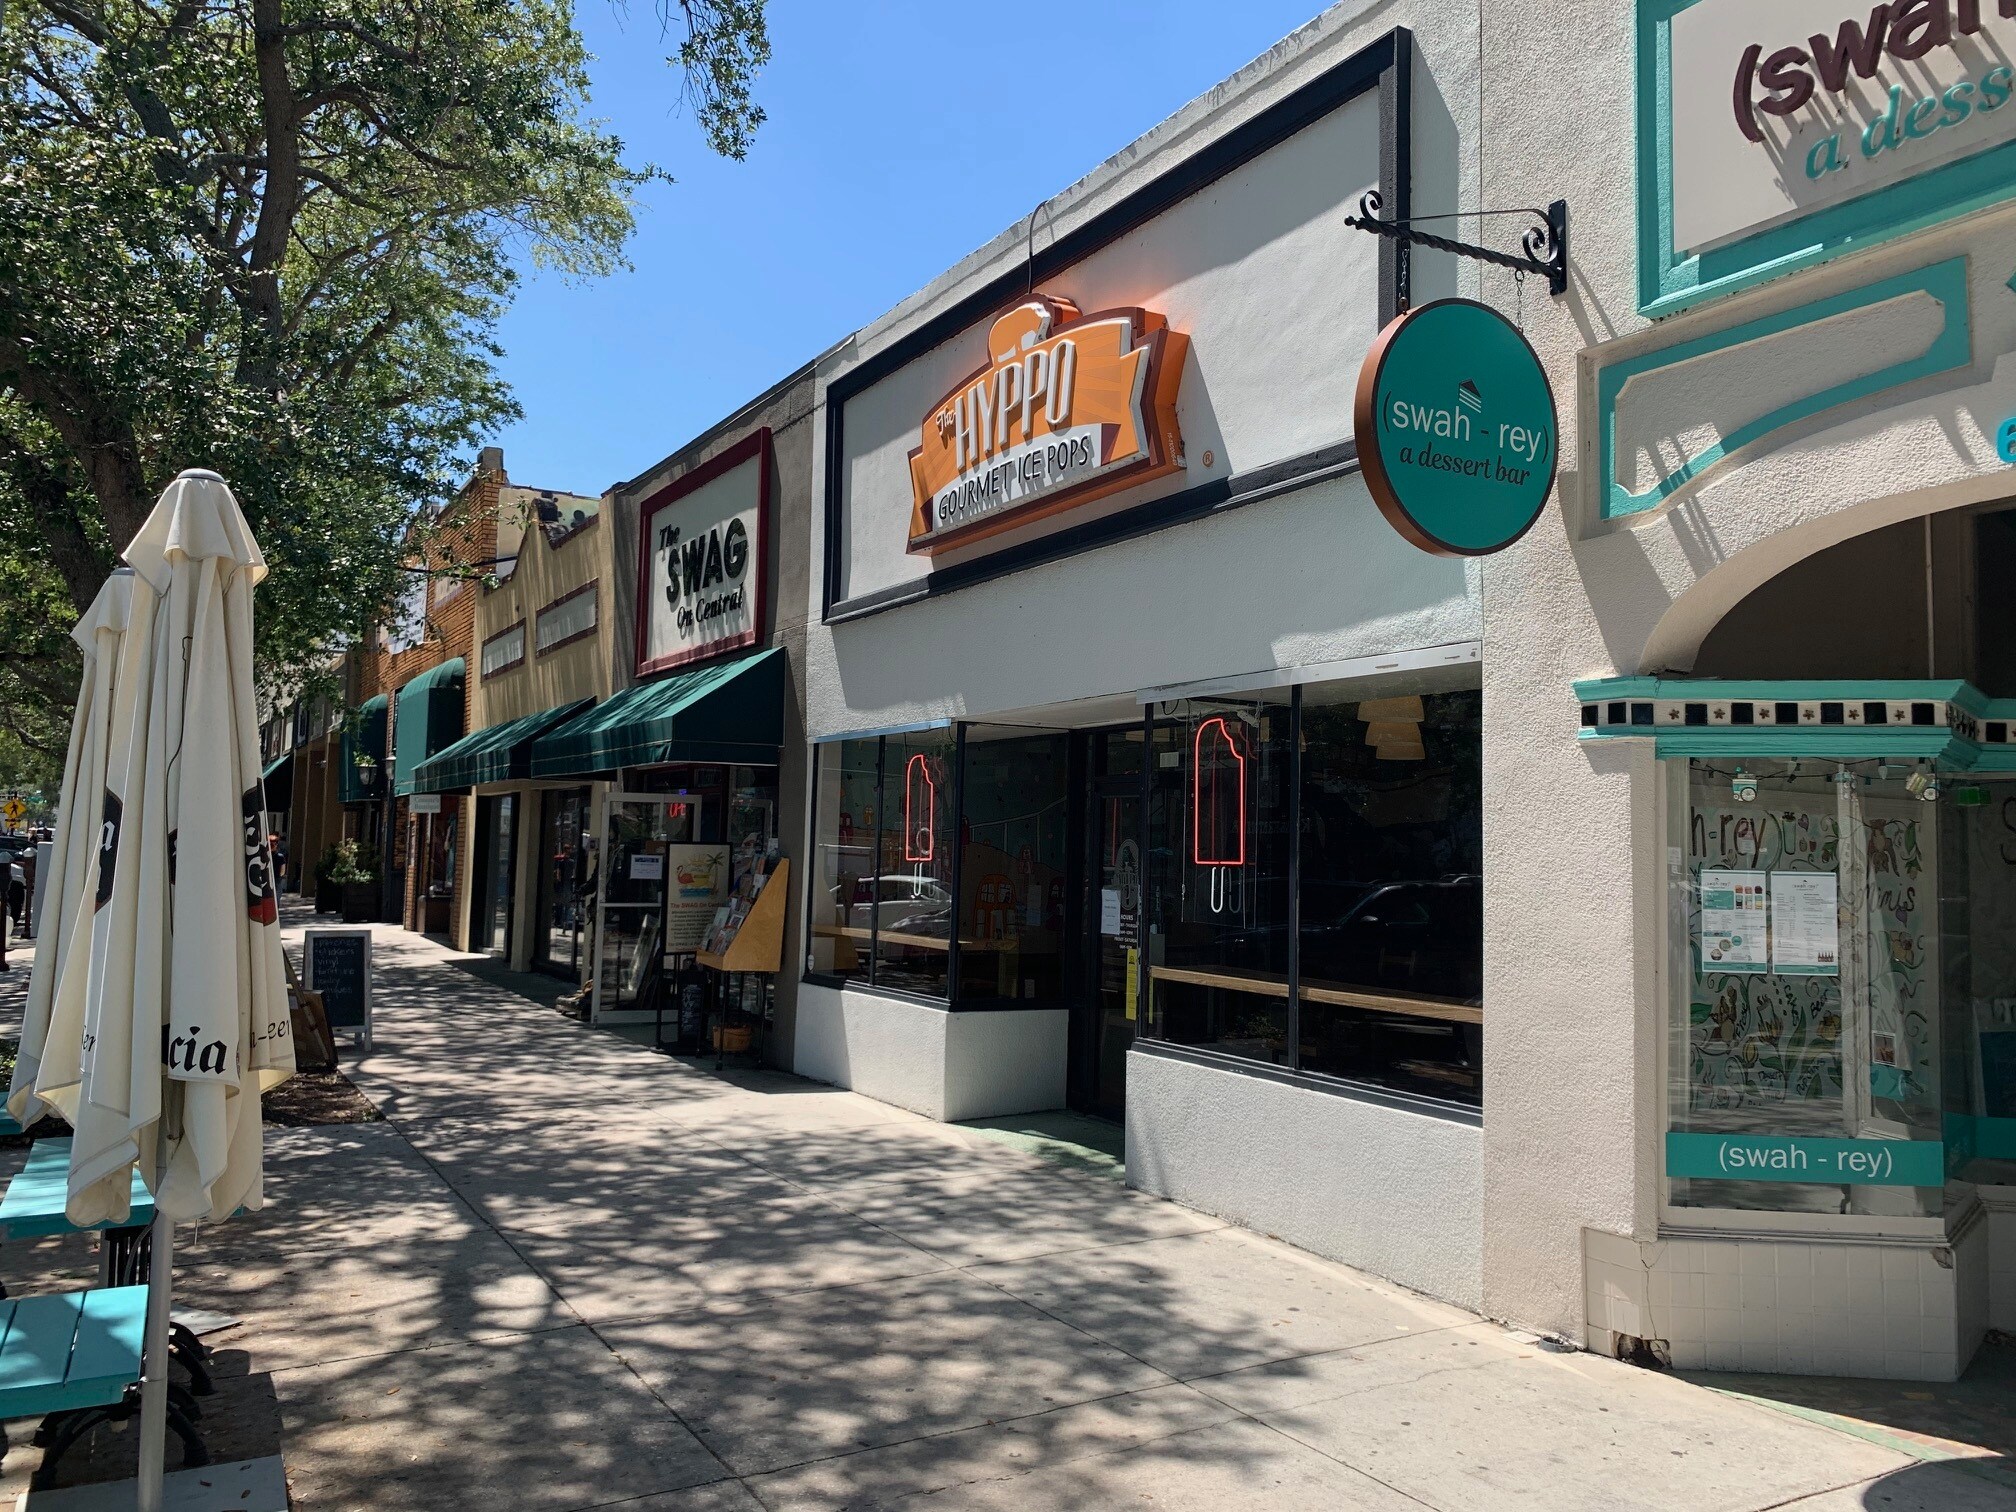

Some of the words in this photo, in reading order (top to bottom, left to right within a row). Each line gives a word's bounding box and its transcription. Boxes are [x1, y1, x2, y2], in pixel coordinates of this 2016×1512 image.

[1805, 133, 1850, 180] a
[936, 403, 957, 437] The
[955, 338, 1077, 470] HYPPO
[1383, 391, 1470, 442] (swah
[1499, 423, 1549, 464] rey)
[938, 464, 1010, 520] GOURMET
[1017, 452, 1042, 484] ICE
[1047, 434, 1089, 472] POPS
[1400, 447, 1414, 465] a
[1418, 441, 1492, 479] dessert
[1495, 455, 1531, 486] bar
[659, 524, 680, 551] The
[666, 517, 748, 604] SWAG
[677, 606, 693, 629] On
[695, 581, 744, 623] Central
[1719, 1141, 1807, 1172] (swah
[1837, 1147, 1892, 1178] rey)
